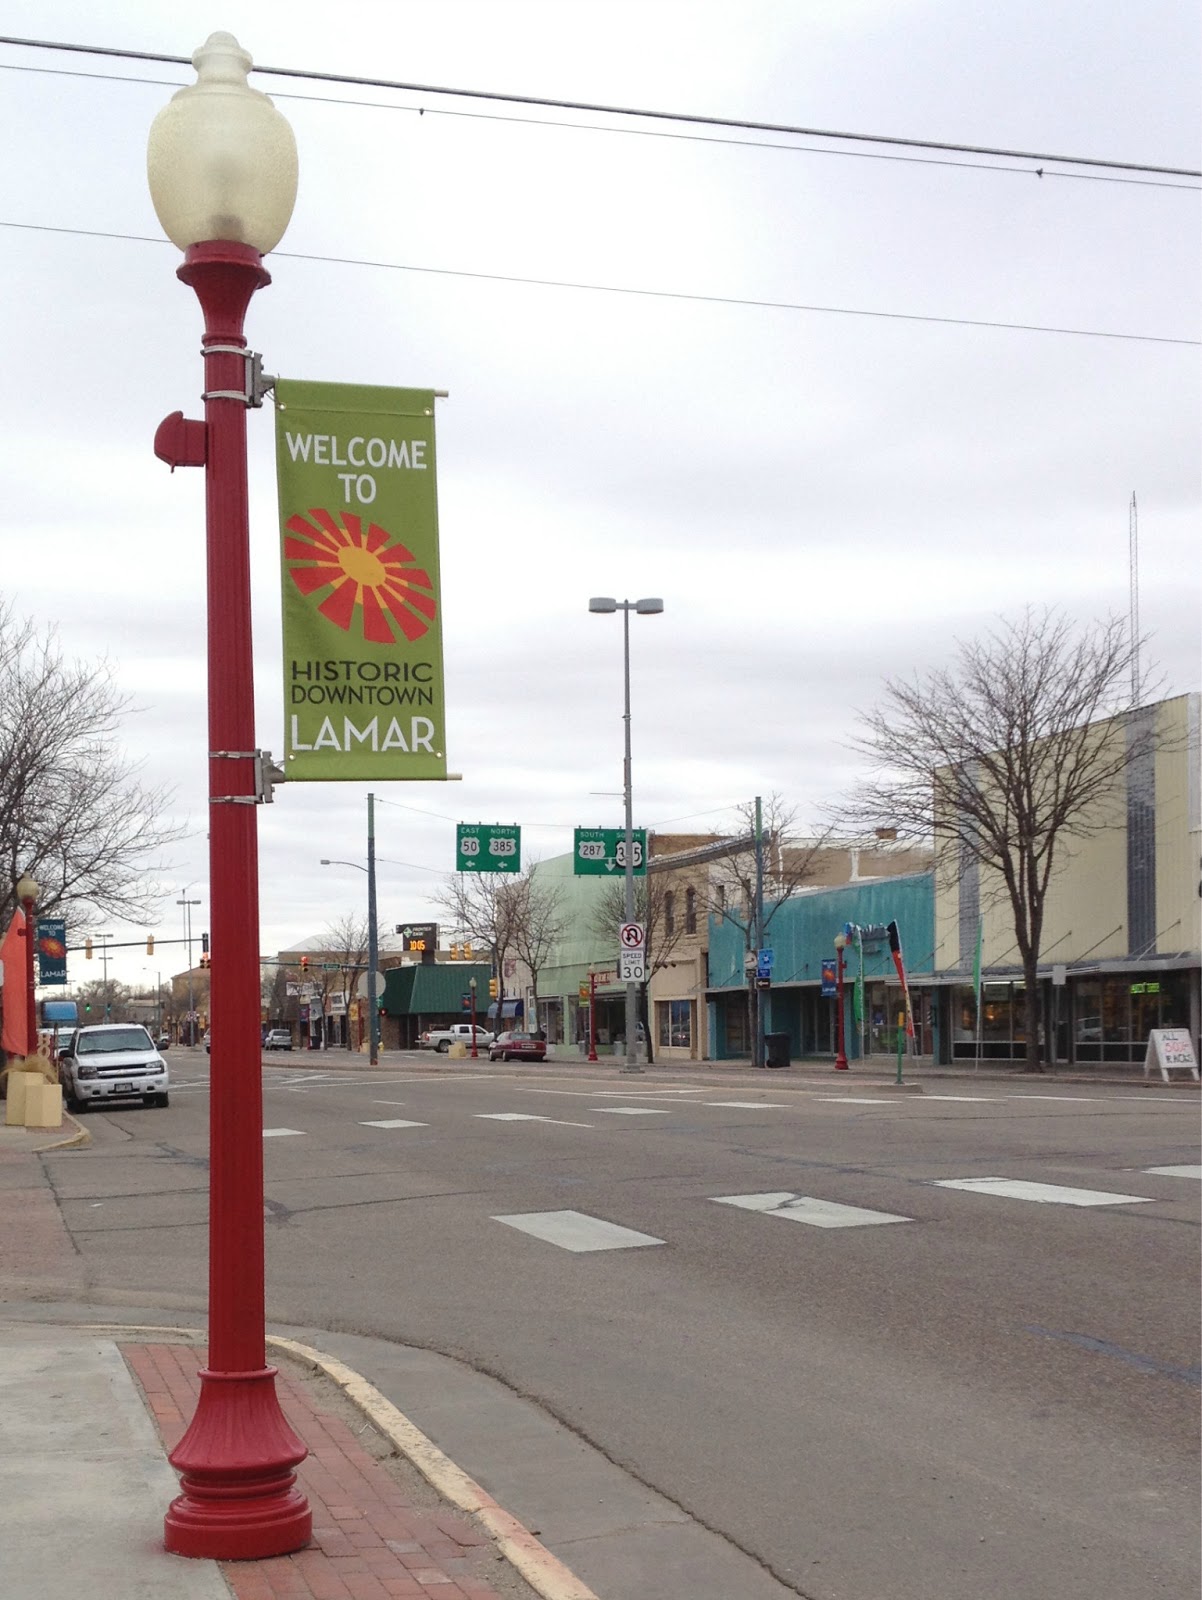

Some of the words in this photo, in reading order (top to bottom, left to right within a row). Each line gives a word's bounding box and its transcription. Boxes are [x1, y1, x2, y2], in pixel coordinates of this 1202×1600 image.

[285, 432, 427, 470] WELCOME
[337, 473, 377, 504] TO
[291, 660, 433, 683] HISTORIC
[291, 684, 433, 706] DOWNTOWN
[290, 714, 435, 754] LAMAR
[463, 841, 478, 852] 50
[493, 842, 513, 852] 385
[582, 845, 601, 855] 287
[618, 846, 642, 861] 35
[40, 969, 66, 978] LAMAR
[623, 966, 643, 979] 30
